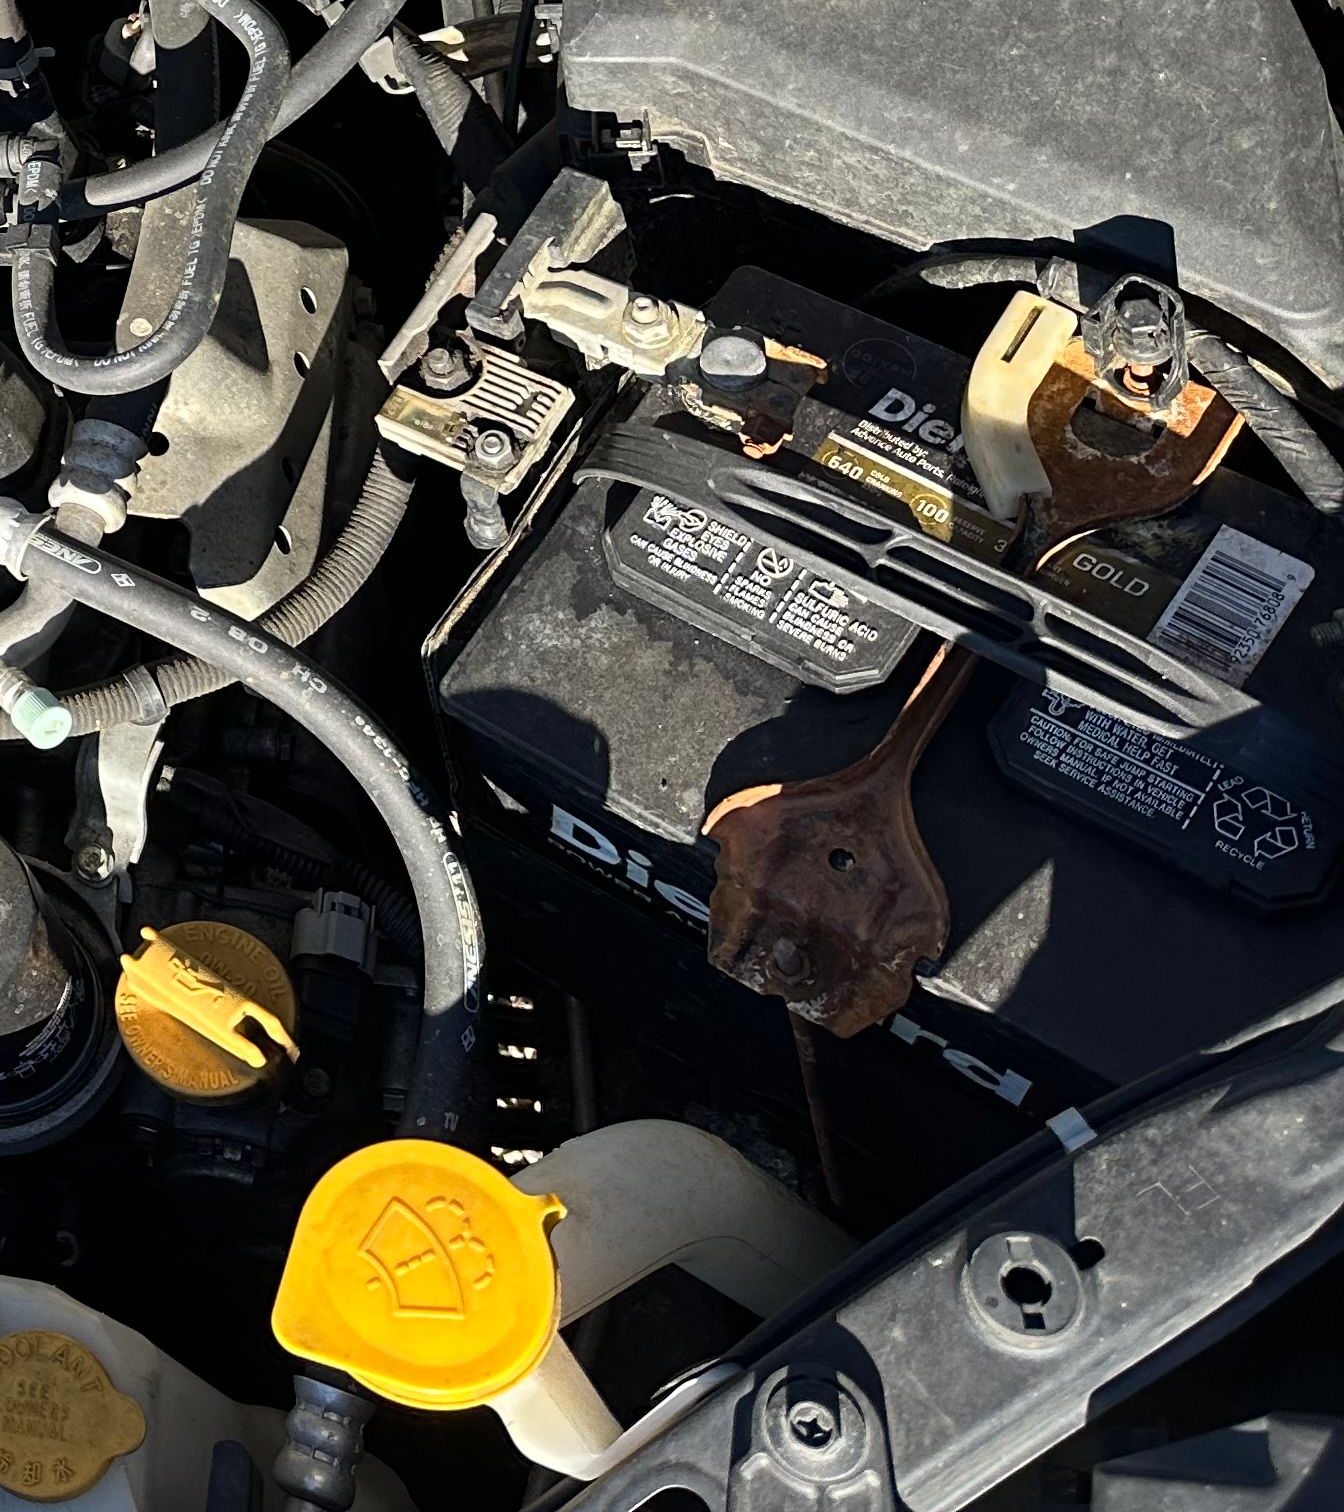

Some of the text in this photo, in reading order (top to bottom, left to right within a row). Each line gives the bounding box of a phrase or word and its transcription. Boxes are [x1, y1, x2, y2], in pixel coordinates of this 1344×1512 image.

[199, 169, 215, 186] DO
[181, 257, 199, 287] FUEL
[21, 311, 40, 339] FUEL
[850, 426, 892, 455] Advance
[892, 444, 917, 465] Auto
[827, 455, 865, 482] 640
[869, 468, 892, 485] COLD
[915, 498, 951, 524] 100
[629, 534, 648, 551] CAN
[646, 542, 674, 564] CAUSE
[668, 527, 728, 564] EXPLOSIVE
[700, 530, 731, 551] EYES
[708, 520, 748, 548] SHIELD
[662, 538, 698, 563] GASES
[733, 575, 773, 601] SPARKS
[750, 570, 772, 587] NO
[1072, 552, 1150, 598] GOLD
[776, 619, 813, 646] SEVERE
[782, 610, 856, 654] BLINDNESS OR
[787, 602, 845, 636] CAN CAUSE
[793, 591, 879, 643] SULFURIC ACID
[1077, 720, 1120, 751] MEDICAL
[1122, 742, 1152, 767] HELP
[1149, 755, 1180, 777] FAST
[1083, 709, 1112, 731] WITH
[1151, 742, 1175, 760] GET
[1027, 725, 1187, 811] FOLLOW INSTRUCTIONS IN VEHICLE
[1032, 750, 1058, 771] SEEK
[1057, 761, 1096, 790] SERVICE
[1073, 736, 1095, 754] FOR
[1094, 746, 1120, 765] SAFE
[1119, 757, 1147, 778] JUMP
[1146, 772, 1196, 803] STARTING
[1217, 775, 1246, 793] LEAD
[1100, 772, 1112, 785] IF
[1111, 777, 1133, 795] NOT
[1132, 788, 1185, 821] AVAILABLE
[1299, 811, 1317, 851] RETURN
[1214, 838, 1266, 872] RECYCLE
[183, 924, 291, 1004] ENGINE OIL
[119, 992, 240, 1091] SEE OWNER'S MANUAL
[16, 1379, 51, 1401] SEE
[1, 1414, 66, 1441] MANUAL
